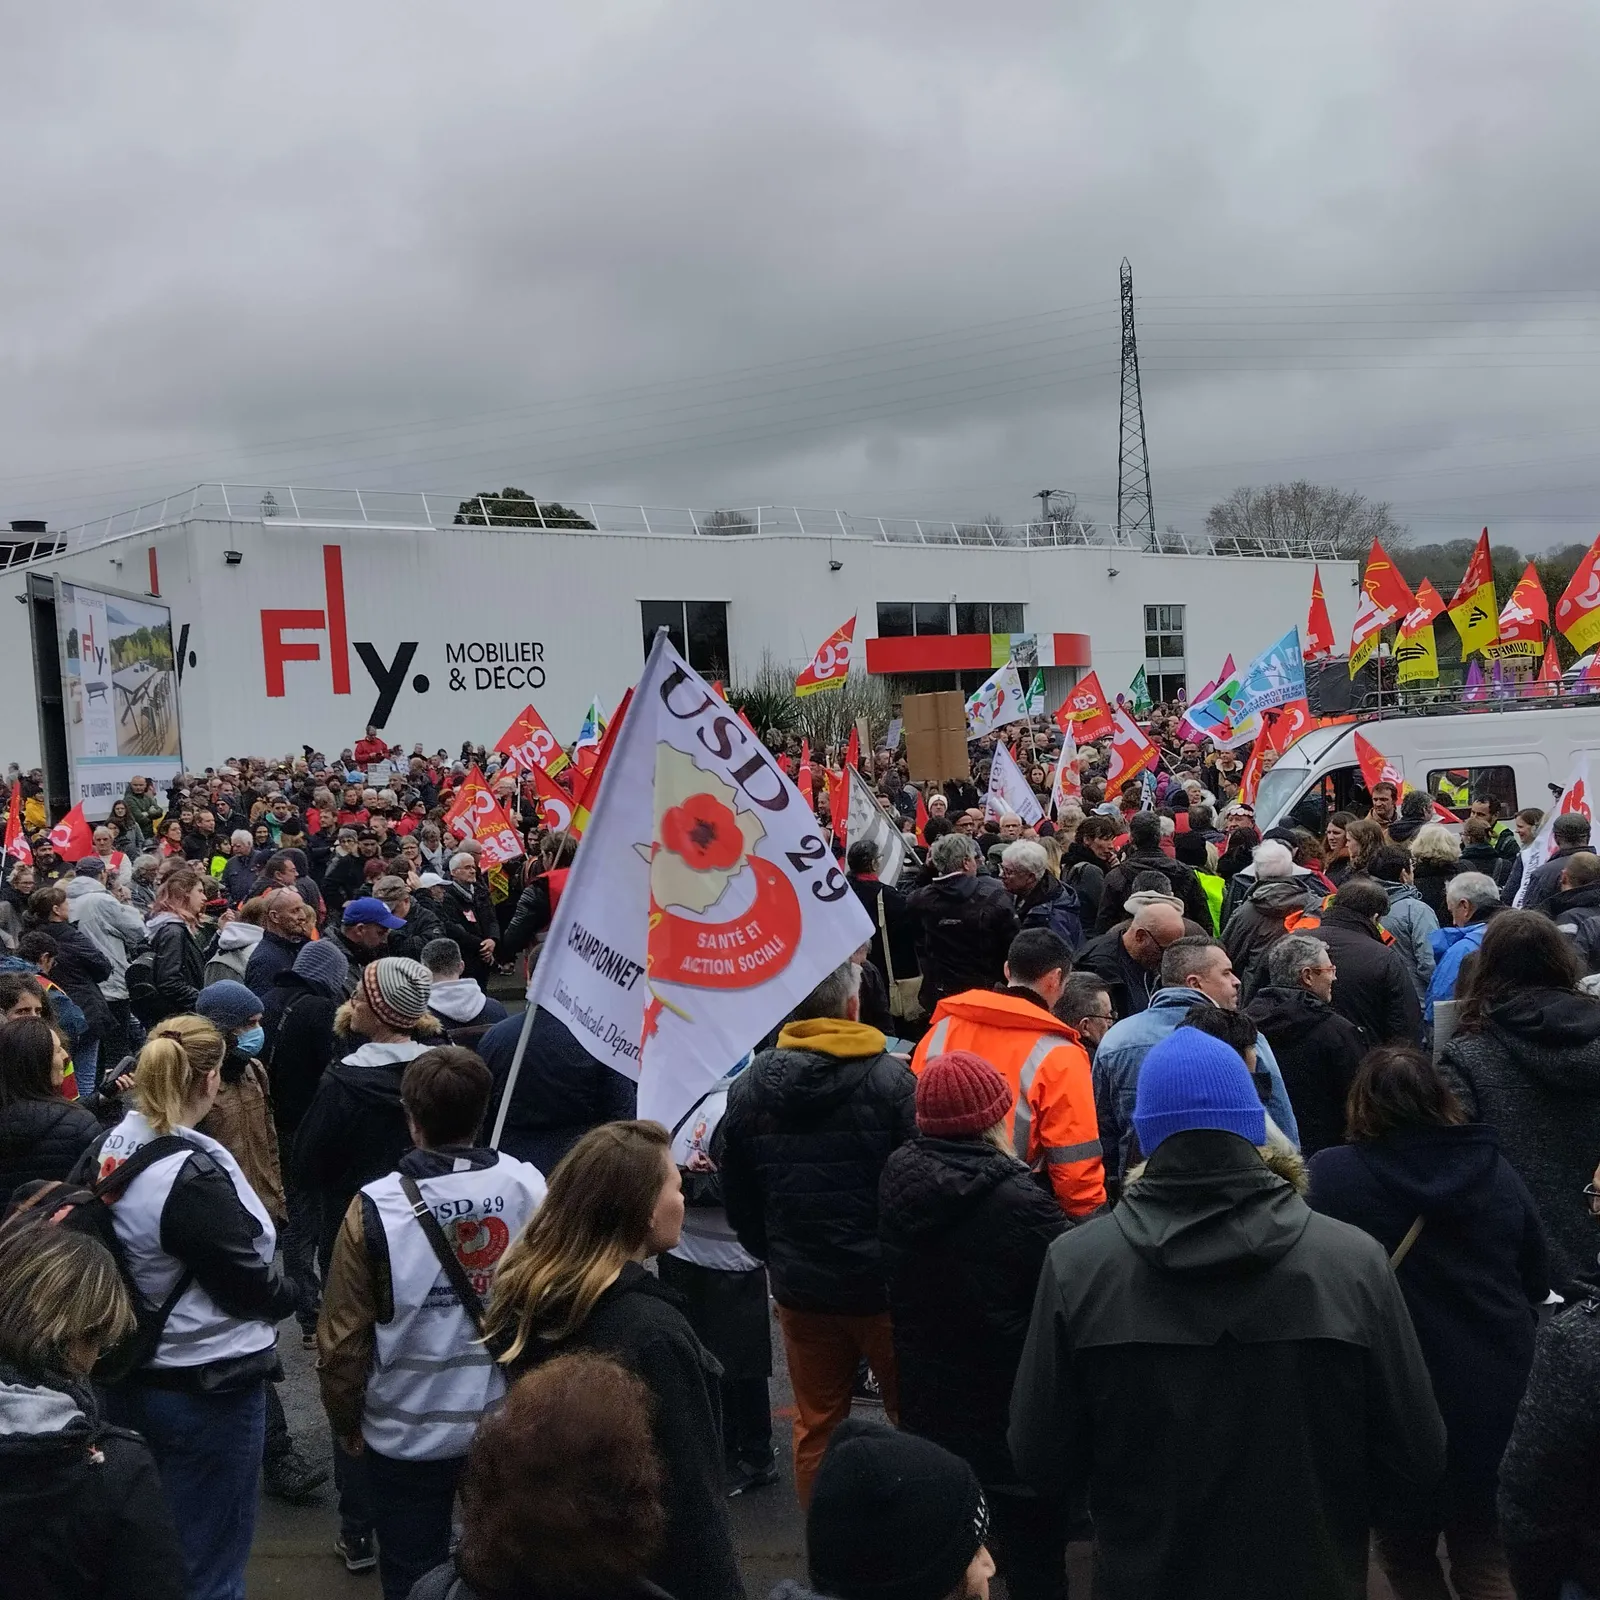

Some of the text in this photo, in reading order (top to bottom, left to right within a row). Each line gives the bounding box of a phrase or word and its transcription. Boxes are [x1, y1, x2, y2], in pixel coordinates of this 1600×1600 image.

[260, 544, 430, 730] Fly.
[446, 642, 545, 663] MOBILIER
[449, 668, 467, 691] &
[660, 661, 849, 902] USD 29
[696, 919, 763, 949] SANTÉ ET
[567, 921, 646, 991] CHAMPIONNET
[679, 955, 736, 975] ACTION
[482, 1195, 504, 1214] 29
